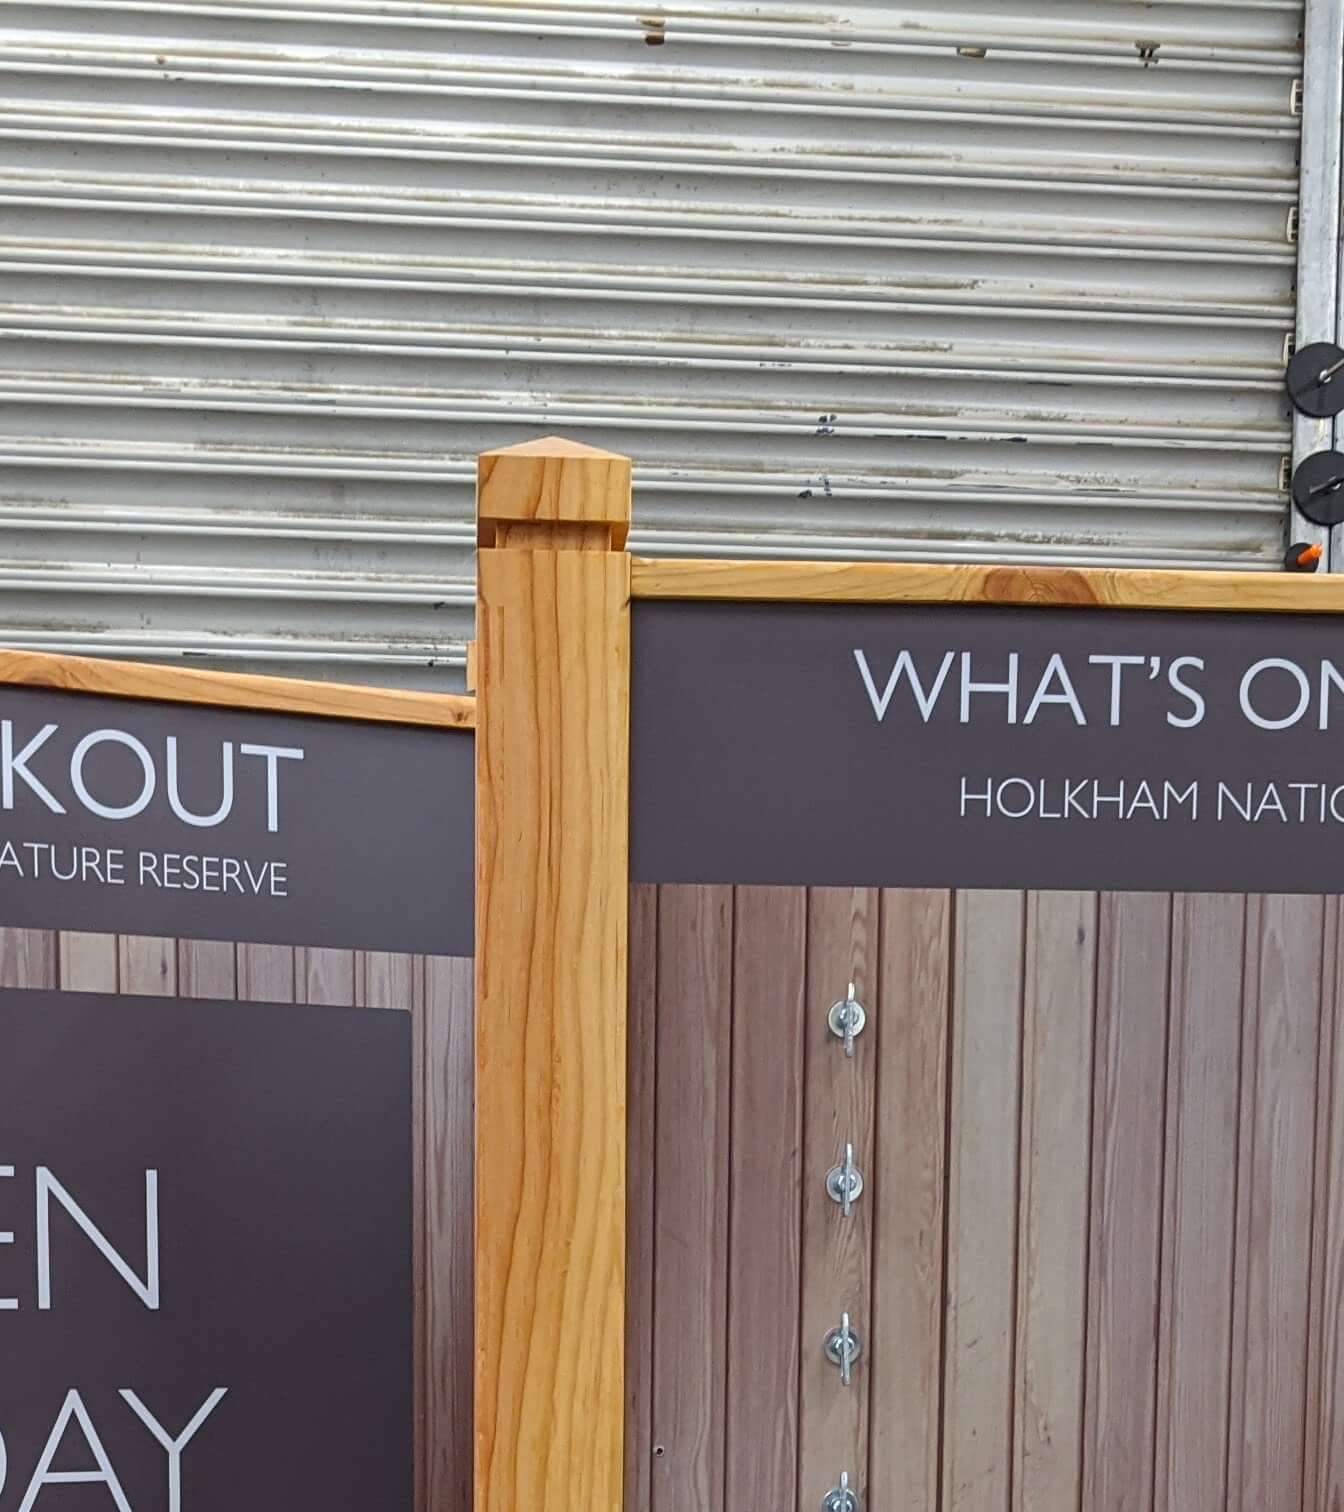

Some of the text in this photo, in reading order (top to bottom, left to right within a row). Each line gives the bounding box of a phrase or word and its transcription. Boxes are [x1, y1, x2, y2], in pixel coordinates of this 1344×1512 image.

[853, 649, 1205, 728] WHAT'S
[960, 776, 1198, 820] HOLKHAM
[139, 851, 288, 897] RESERVE
